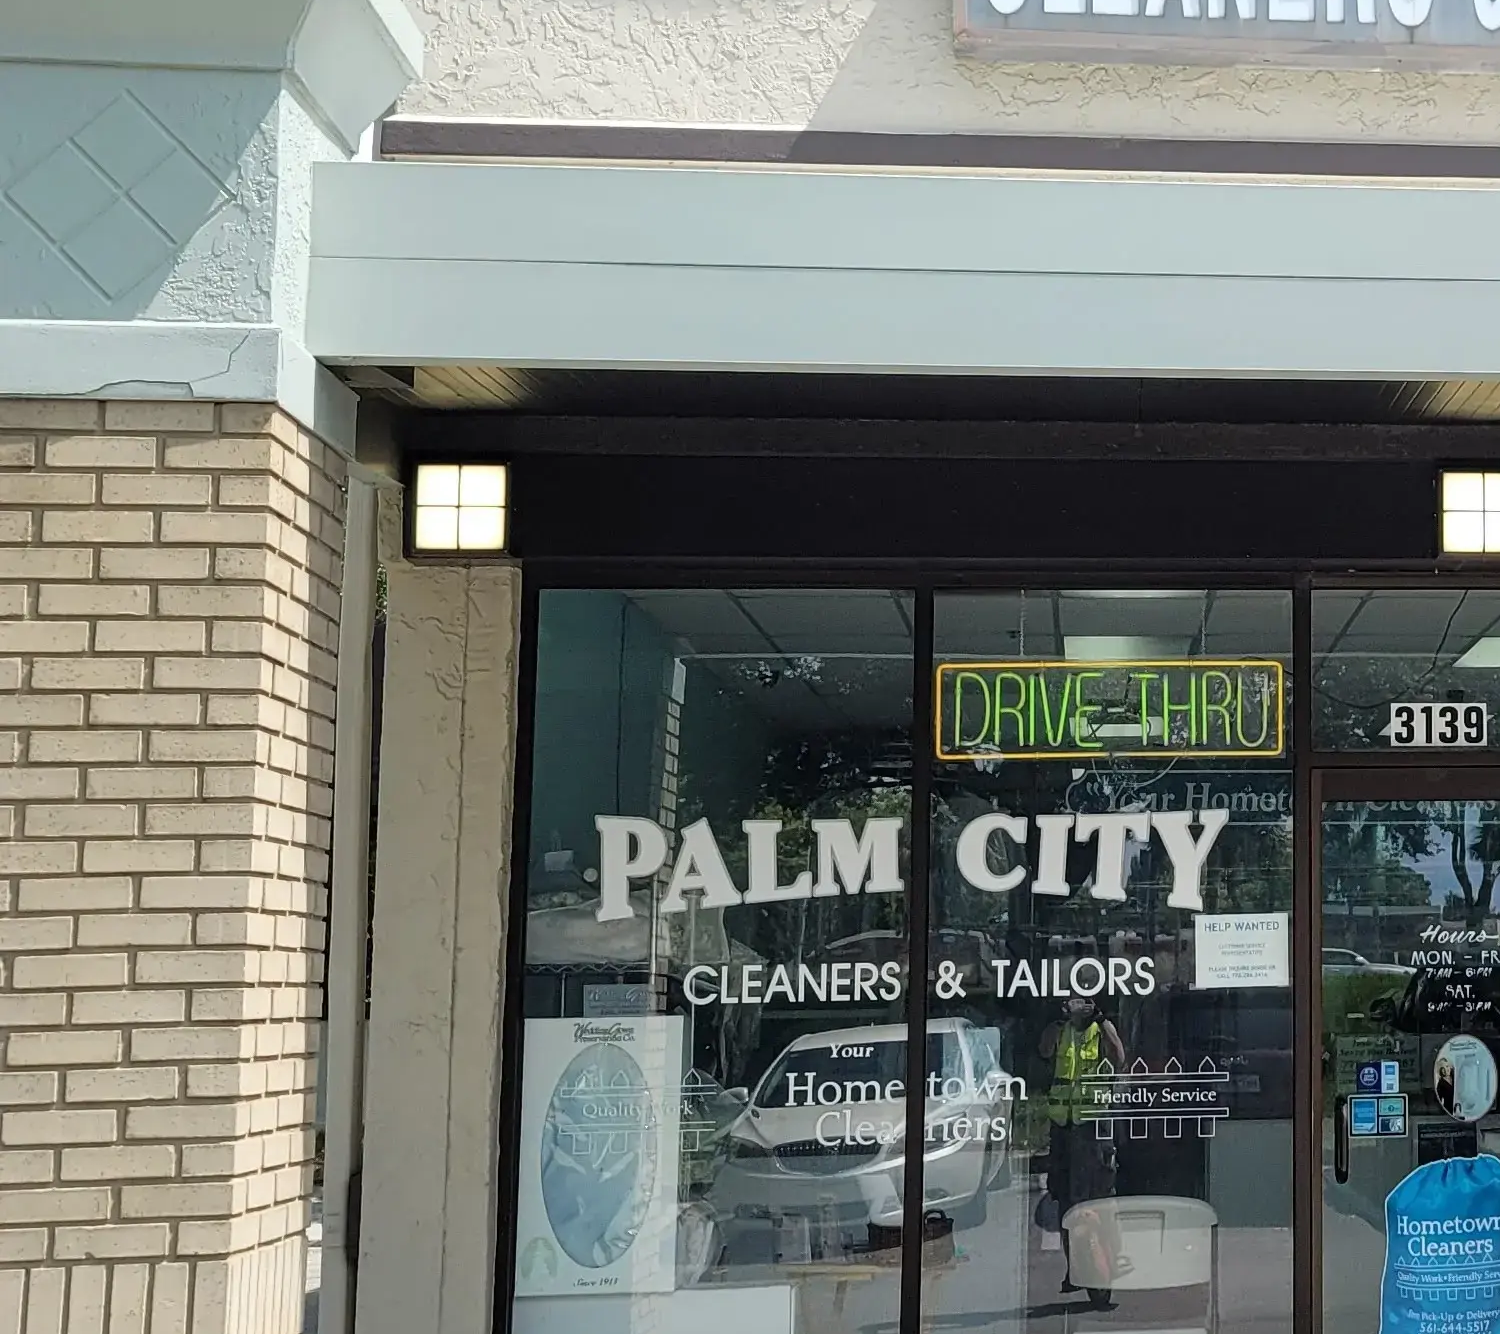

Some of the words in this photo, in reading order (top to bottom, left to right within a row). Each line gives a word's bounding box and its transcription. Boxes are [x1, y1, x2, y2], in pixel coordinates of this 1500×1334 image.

[1394, 705, 1484, 744] 3139
[594, 814, 905, 922] PALM
[956, 808, 1229, 911] CITY
[1204, 922, 1231, 933] HELP
[1234, 921, 1280, 932] WANTED
[1420, 924, 1499, 944] Hours
[1410, 950, 1456, 965] MON.
[683, 961, 901, 1005] CLEANERS
[935, 961, 966, 999] &
[992, 956, 1155, 998] TAILORS
[829, 1043, 875, 1059] Your
[1093, 1088, 1158, 1107] Friendly
[1161, 1087, 1217, 1103] Service
[582, 1101, 642, 1122] Quality
[1407, 1236, 1494, 1257] Cleaners
[1466, 1308, 1500, 1321] Delivery
[1419, 1320, 1490, 1334] 561-644-5517
